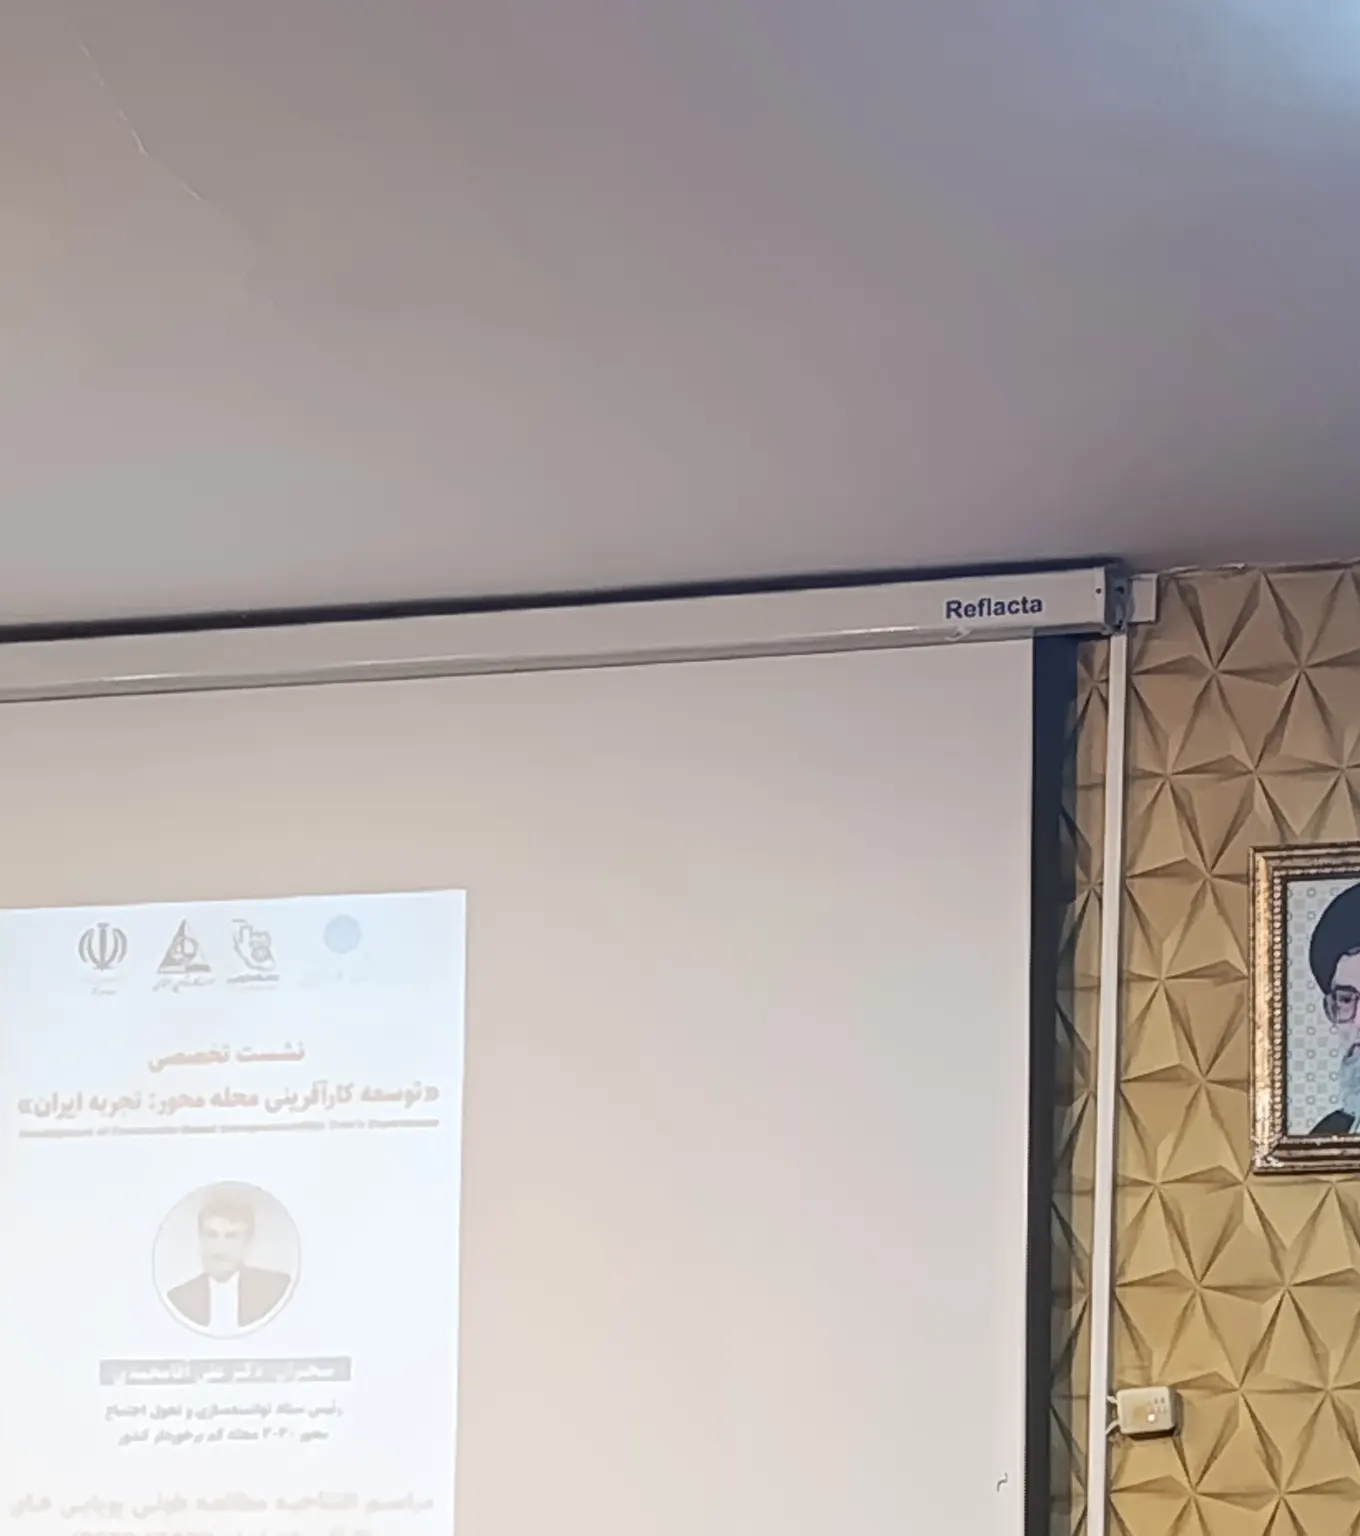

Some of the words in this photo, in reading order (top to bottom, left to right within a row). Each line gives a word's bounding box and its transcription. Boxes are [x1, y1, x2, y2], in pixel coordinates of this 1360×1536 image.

[945, 596, 1043, 620] Reflacta
[148, 1044, 230, 1073] تخصصی
[236, 1041, 305, 1062] نشست
[90, 1091, 141, 1117] تجربه
[210, 1086, 259, 1107] محله
[264, 1079, 354, 1113] کارآفرینی
